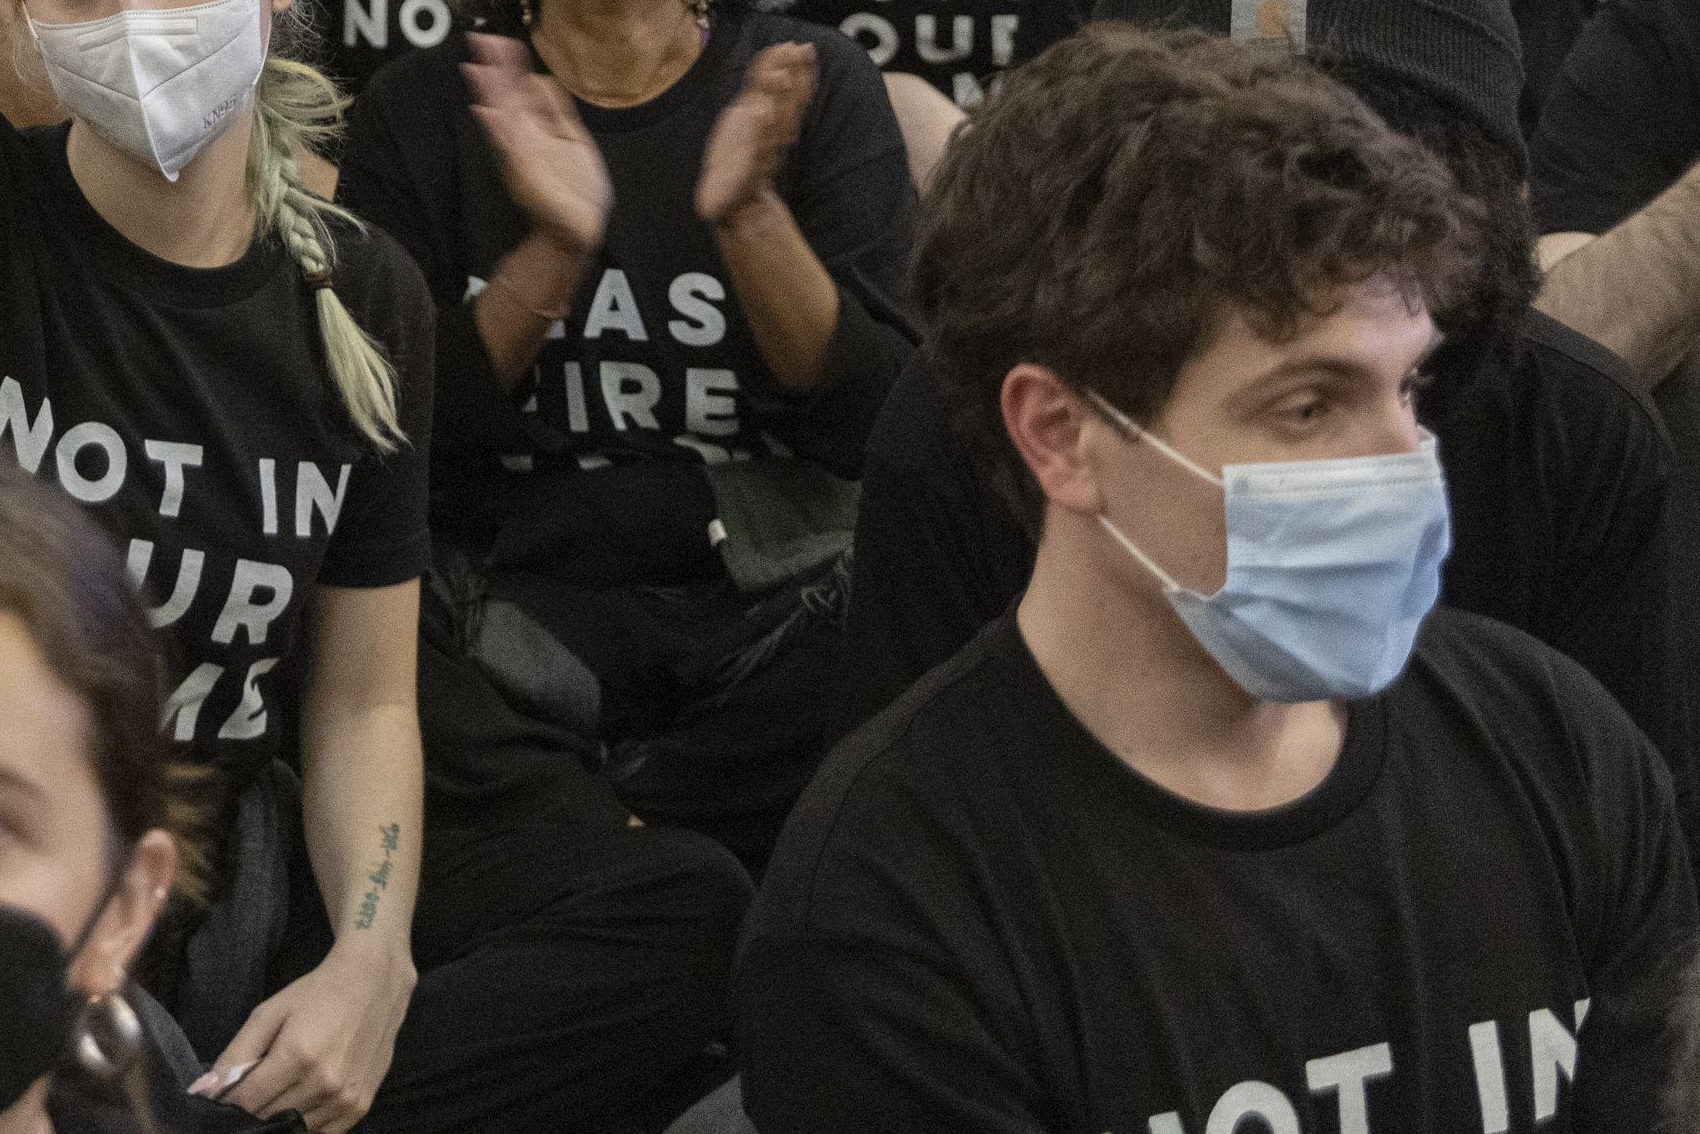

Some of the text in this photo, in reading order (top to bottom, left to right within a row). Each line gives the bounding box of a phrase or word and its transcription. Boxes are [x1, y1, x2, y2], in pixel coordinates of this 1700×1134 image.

[522, 360, 740, 436] IRE
[259, 458, 352, 538] IN
[127, 538, 294, 646] UR
